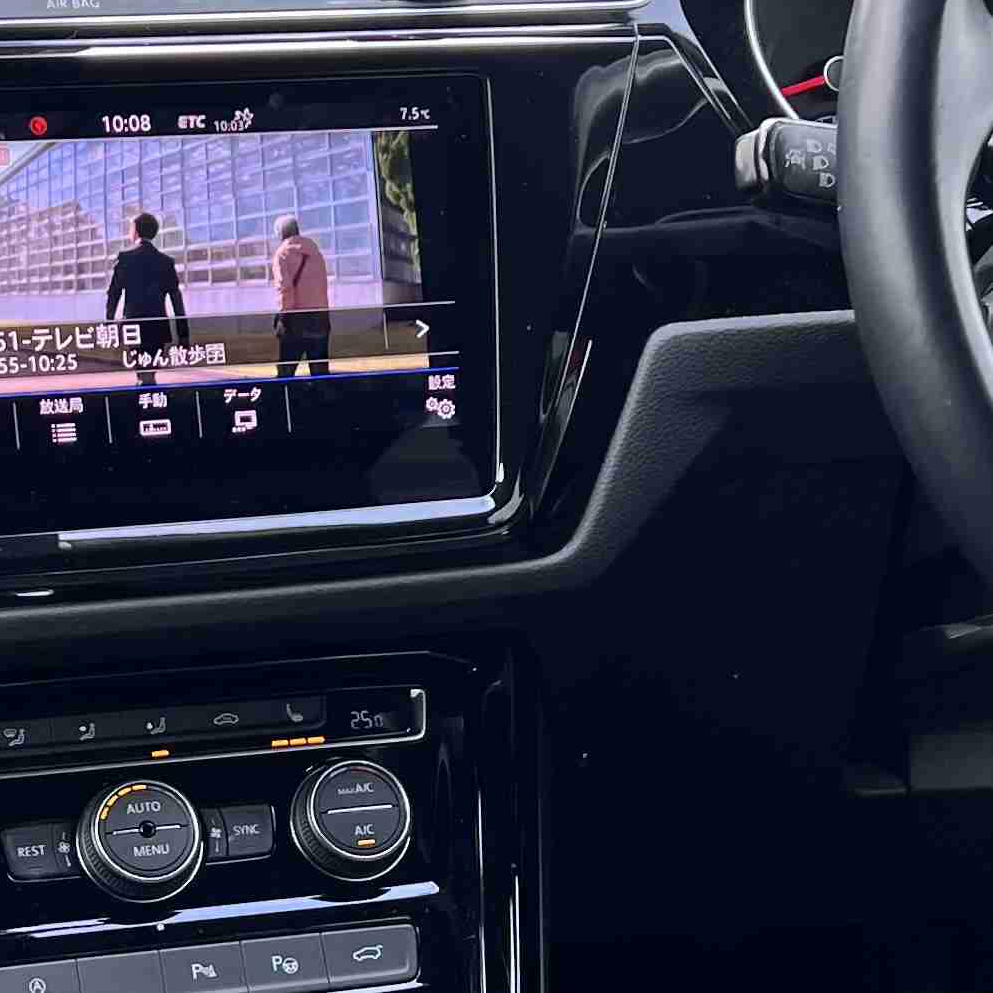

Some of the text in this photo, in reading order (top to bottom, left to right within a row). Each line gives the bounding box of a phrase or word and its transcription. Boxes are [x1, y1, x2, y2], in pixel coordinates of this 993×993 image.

[102, 114, 151, 133] 10:08
[178, 114, 206, 129] ETC
[428, 374, 456, 390] 設定
[138, 392, 167, 409] 手動
[223, 387, 261, 403] データ
[40, 397, 84, 414] 放送局
[126, 801, 161, 815] AUTO
[232, 824, 260, 837] SYNC
[355, 824, 375, 836] A/C
[17, 845, 46, 857] REST
[133, 843, 170, 857] MENU
